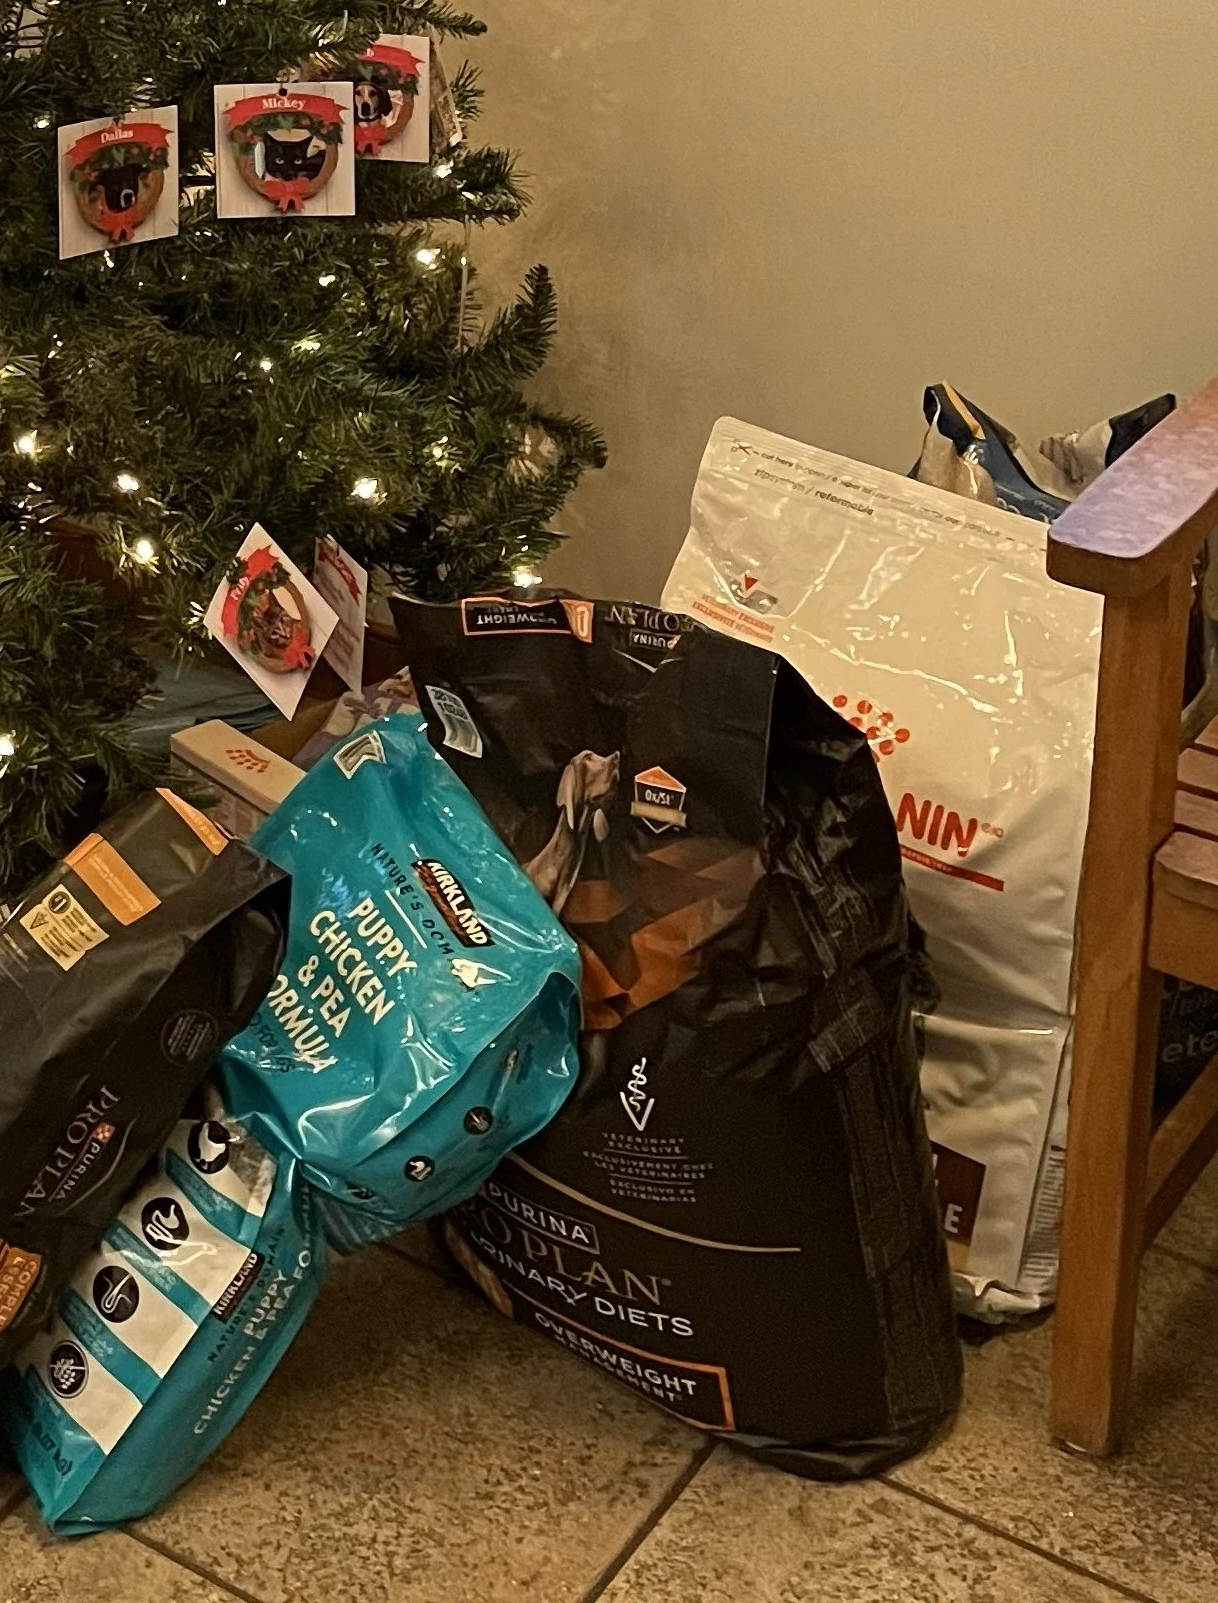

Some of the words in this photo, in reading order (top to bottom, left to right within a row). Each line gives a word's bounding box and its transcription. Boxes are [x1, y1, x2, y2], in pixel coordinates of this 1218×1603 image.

[101, 129, 133, 143] Dallas
[262, 97, 306, 111] Mickey
[896, 792, 978, 857] NIN
[371, 843, 424, 911] NATURE'S
[428, 861, 488, 945] KIRKLAND
[310, 910, 395, 1025] CHICKEN
[347, 897, 418, 977] PUPPY
[267, 974, 339, 1074] ORMULA
[298, 955, 319, 987] &
[311, 975, 351, 1038] PEA
[67, 1085, 120, 1145] PRO
[56, 1142, 101, 1199] PURINA
[489, 1181, 590, 1244] PURINA
[212, 1252, 258, 1316] KIRKLAND
[243, 1269, 287, 1337] PUPPY
[594, 1296, 695, 1337] DIETS
[193, 1346, 256, 1435] CHICKEN
[266, 1283, 296, 1322] PEA
[535, 1312, 697, 1395] OVERWEIGHT
